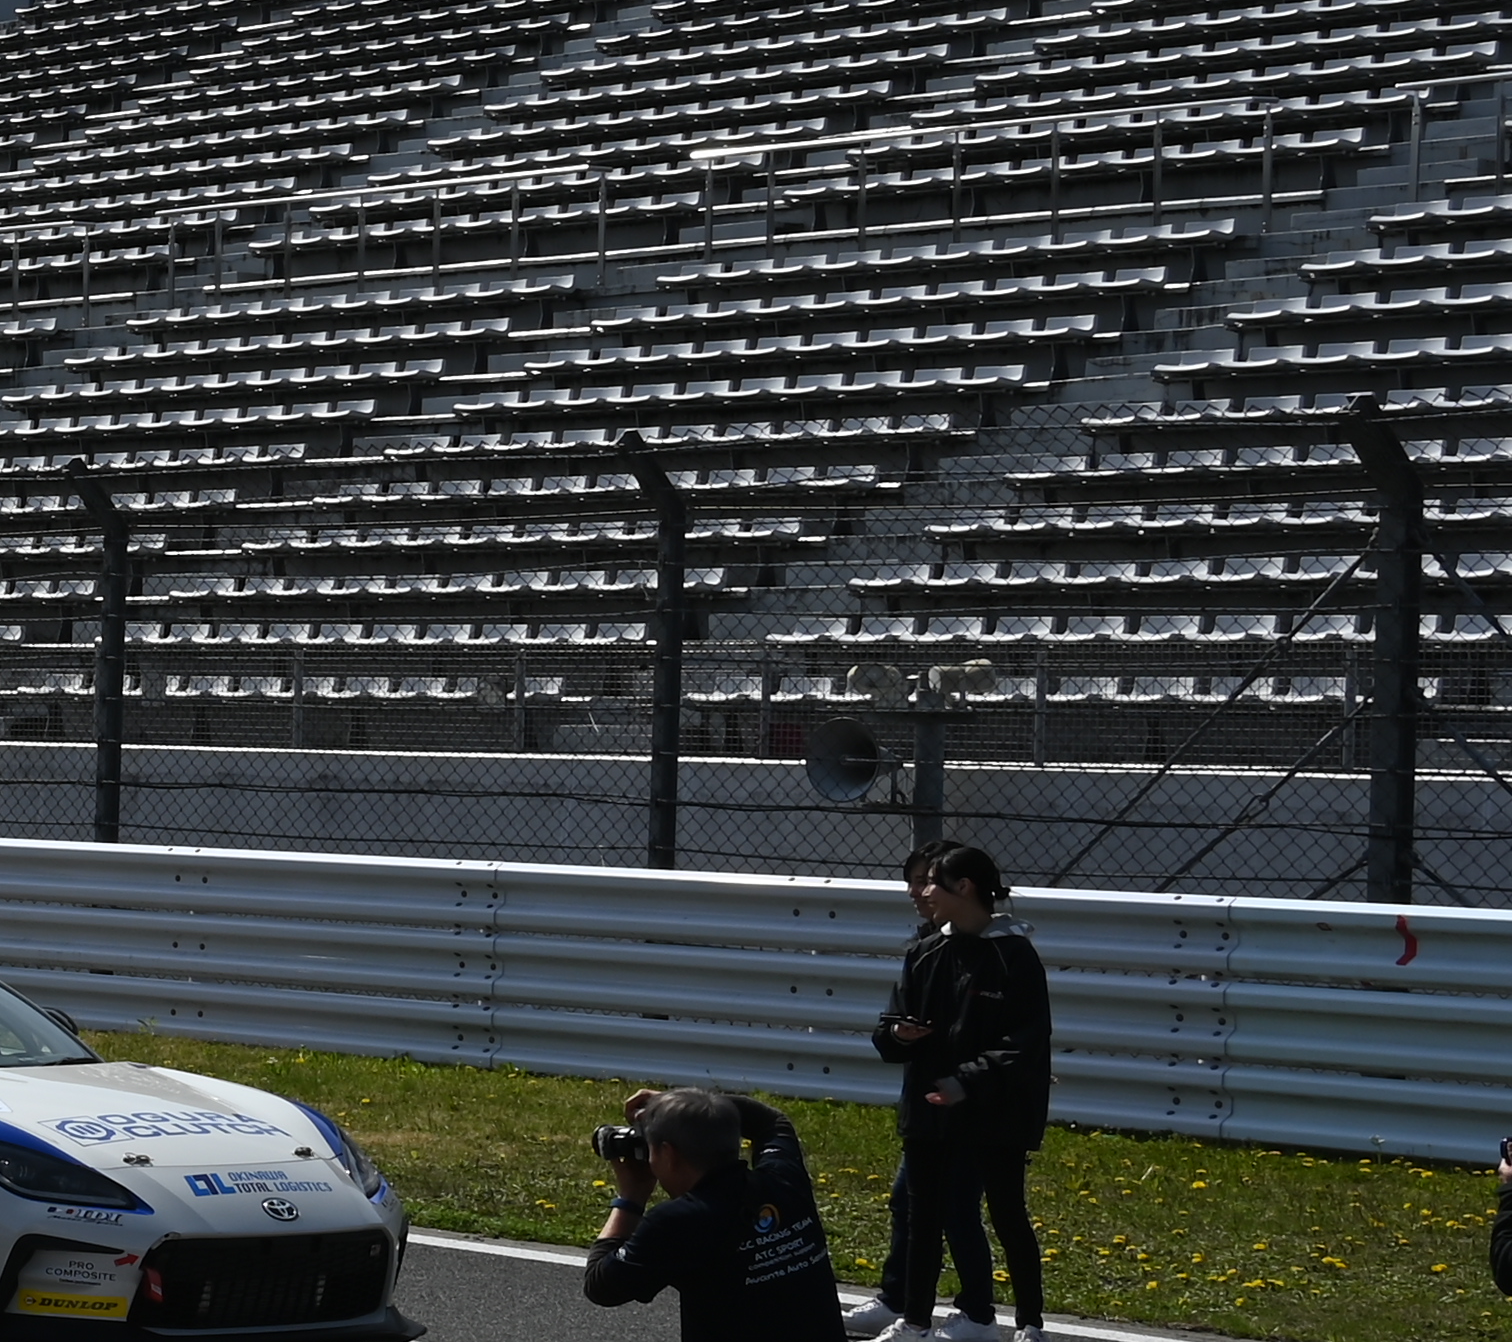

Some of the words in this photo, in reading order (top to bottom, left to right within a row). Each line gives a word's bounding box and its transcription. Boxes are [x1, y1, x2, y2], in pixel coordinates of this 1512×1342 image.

[97, 1111, 270, 1126] OGURA
[123, 1122, 294, 1138] CLUTCH
[227, 1170, 288, 1182] OKINAWA
[234, 1181, 273, 1195] TOTAL
[275, 1180, 333, 1194] LOGISTICS
[755, 1227, 792, 1247] RACING
[791, 1216, 814, 1233] TEAM
[68, 1260, 95, 1271] PRO
[45, 1267, 117, 1282] COMPOSITE
[37, 1297, 119, 1311] DUNLOP
